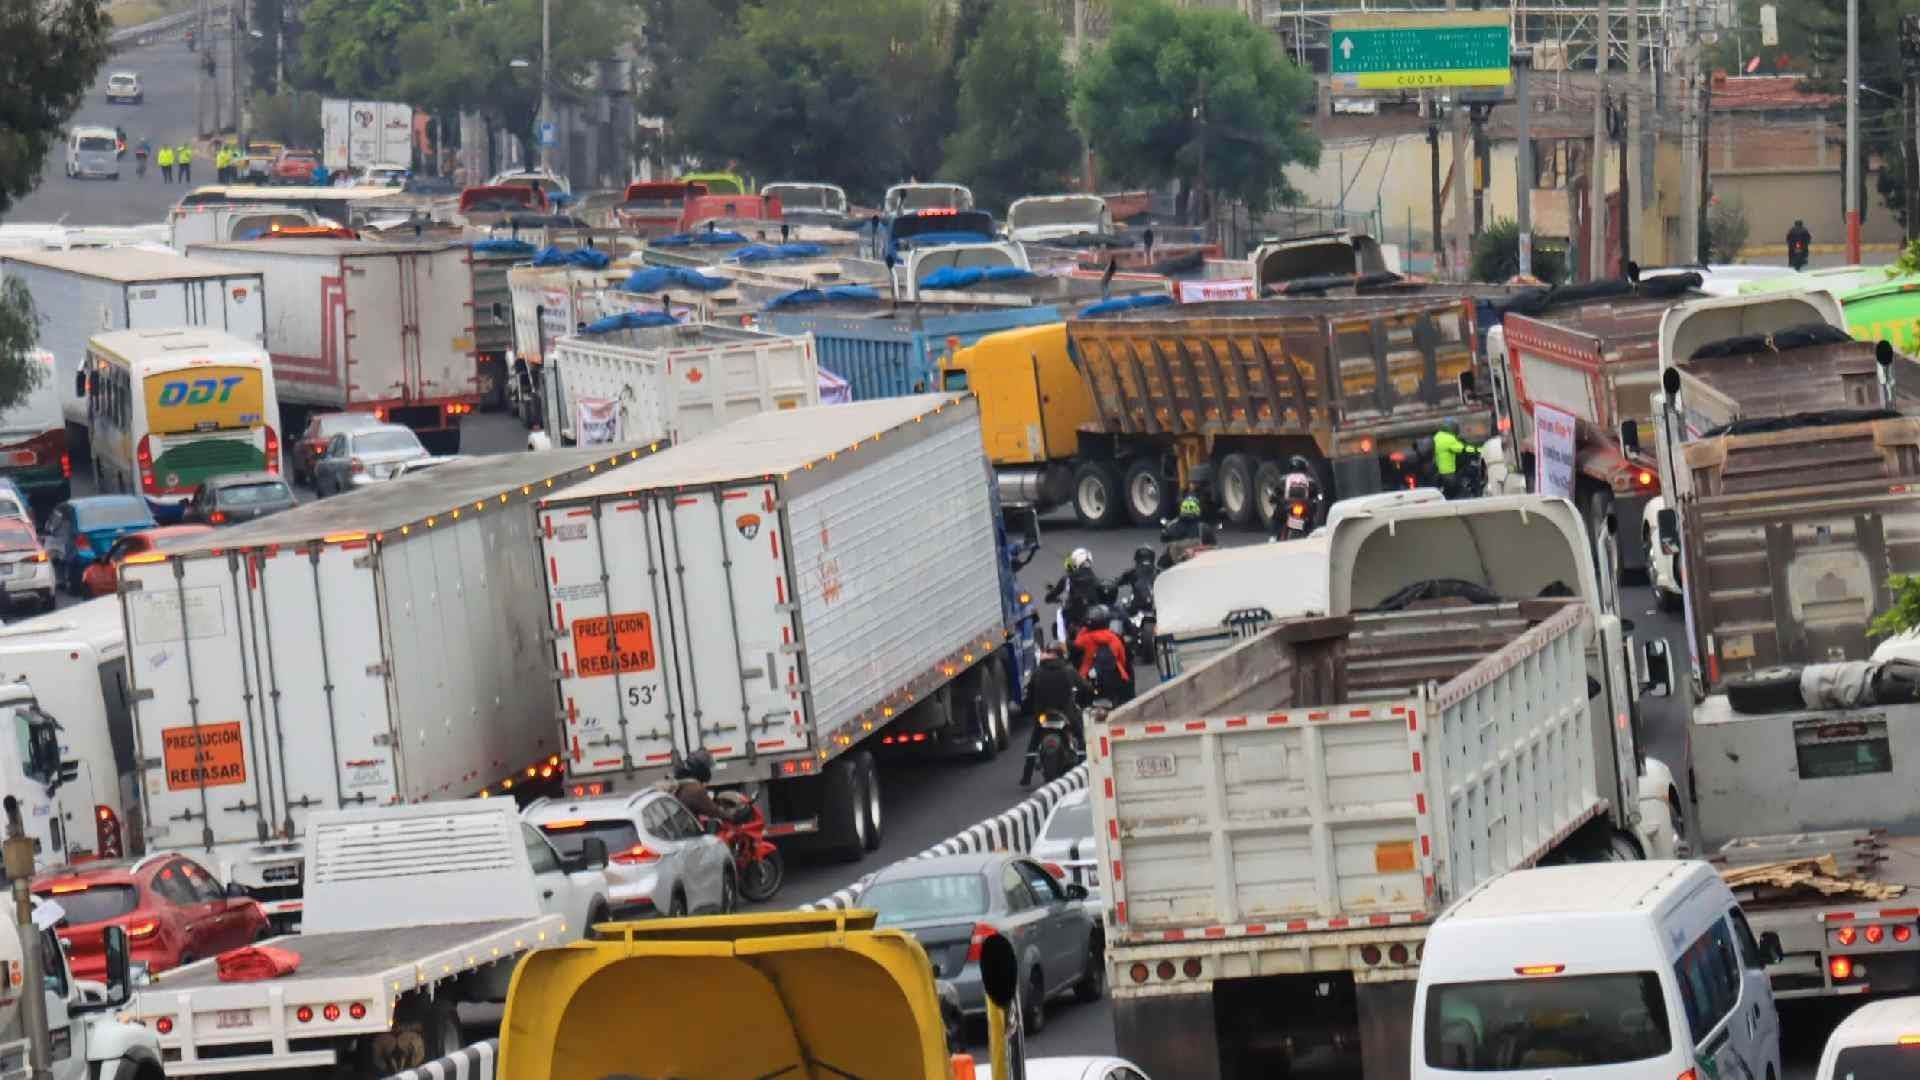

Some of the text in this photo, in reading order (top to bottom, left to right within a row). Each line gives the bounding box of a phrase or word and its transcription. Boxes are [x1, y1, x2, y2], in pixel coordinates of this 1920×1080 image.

[159, 376, 244, 406] DDT
[580, 650, 649, 673] REBASAR
[170, 762, 241, 784] REBASAR
